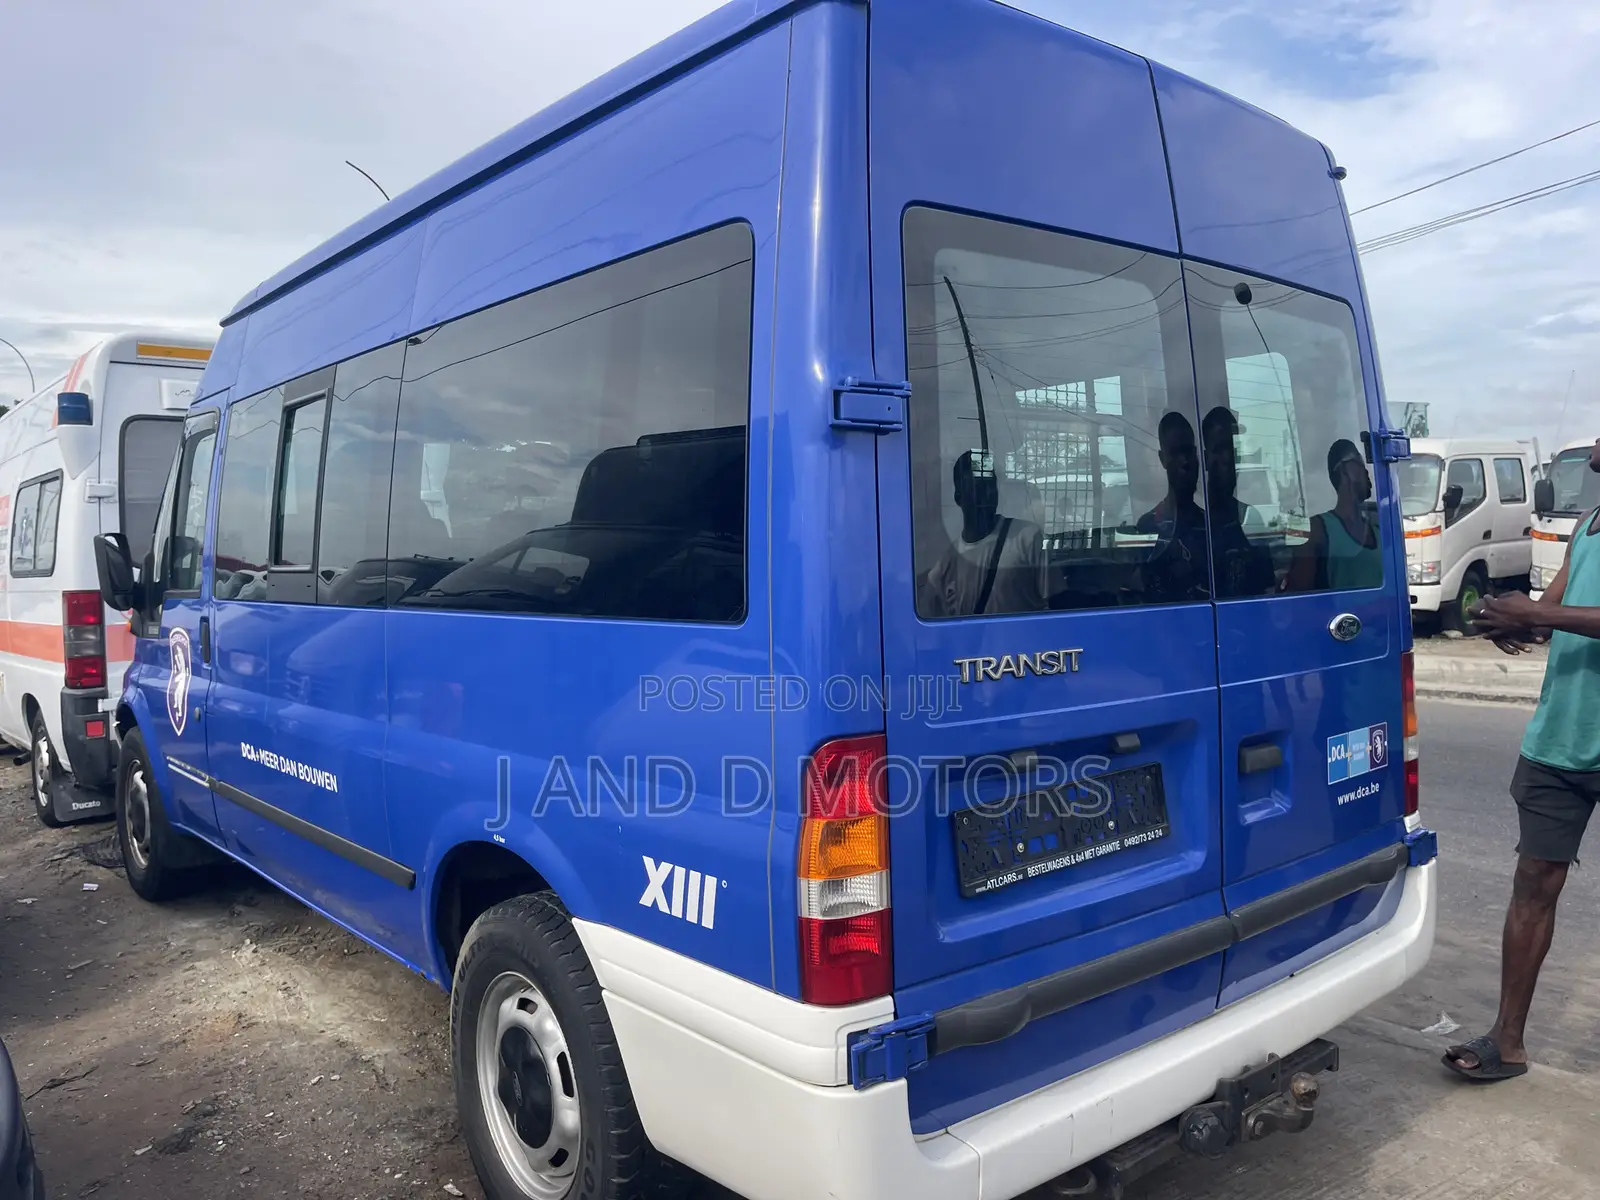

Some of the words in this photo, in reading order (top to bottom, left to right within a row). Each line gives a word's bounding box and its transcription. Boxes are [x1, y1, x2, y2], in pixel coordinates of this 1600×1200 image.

[953, 648, 1084, 683] TRANSIT
[280, 756, 298, 778] DAN
[298, 762, 338, 793] BOUWEN
[72, 800, 101, 810] Ducato
[1338, 782, 1380, 806] www.dca.be
[1027, 856, 1071, 878] BESTELWAGENS
[1085, 848, 1096, 860] MET
[1096, 840, 1121, 857] GARANTIE
[1147, 831, 1155, 841] 24
[1155, 828, 1163, 838] 24
